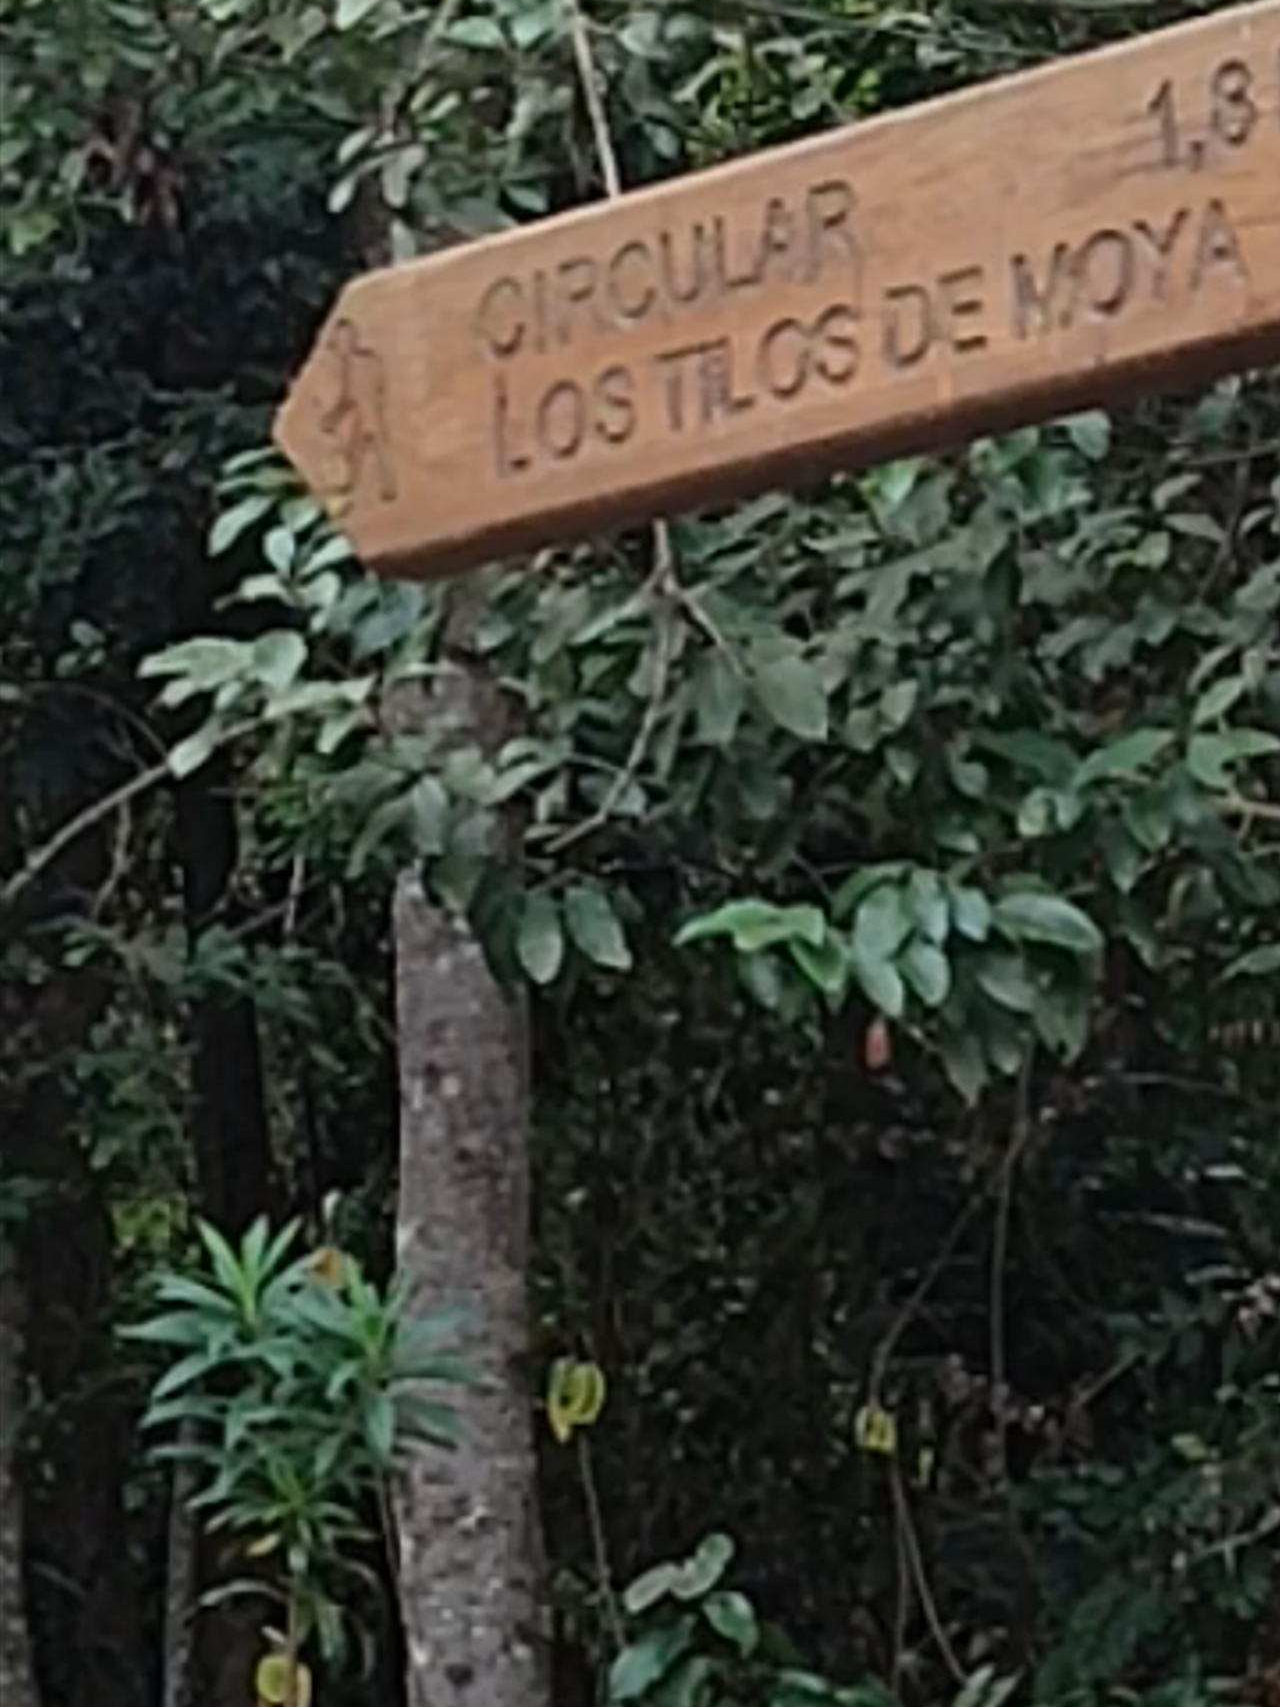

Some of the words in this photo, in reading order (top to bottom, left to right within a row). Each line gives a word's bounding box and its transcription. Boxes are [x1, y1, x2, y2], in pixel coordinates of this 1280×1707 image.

[1144, 60, 1259, 173] 1,8
[473, 179, 862, 361] CIRCULAR
[490, 365, 636, 481] LOS
[654, 303, 862, 434] TILOS
[881, 264, 989, 371] DE
[1010, 198, 1251, 341] MOYA
